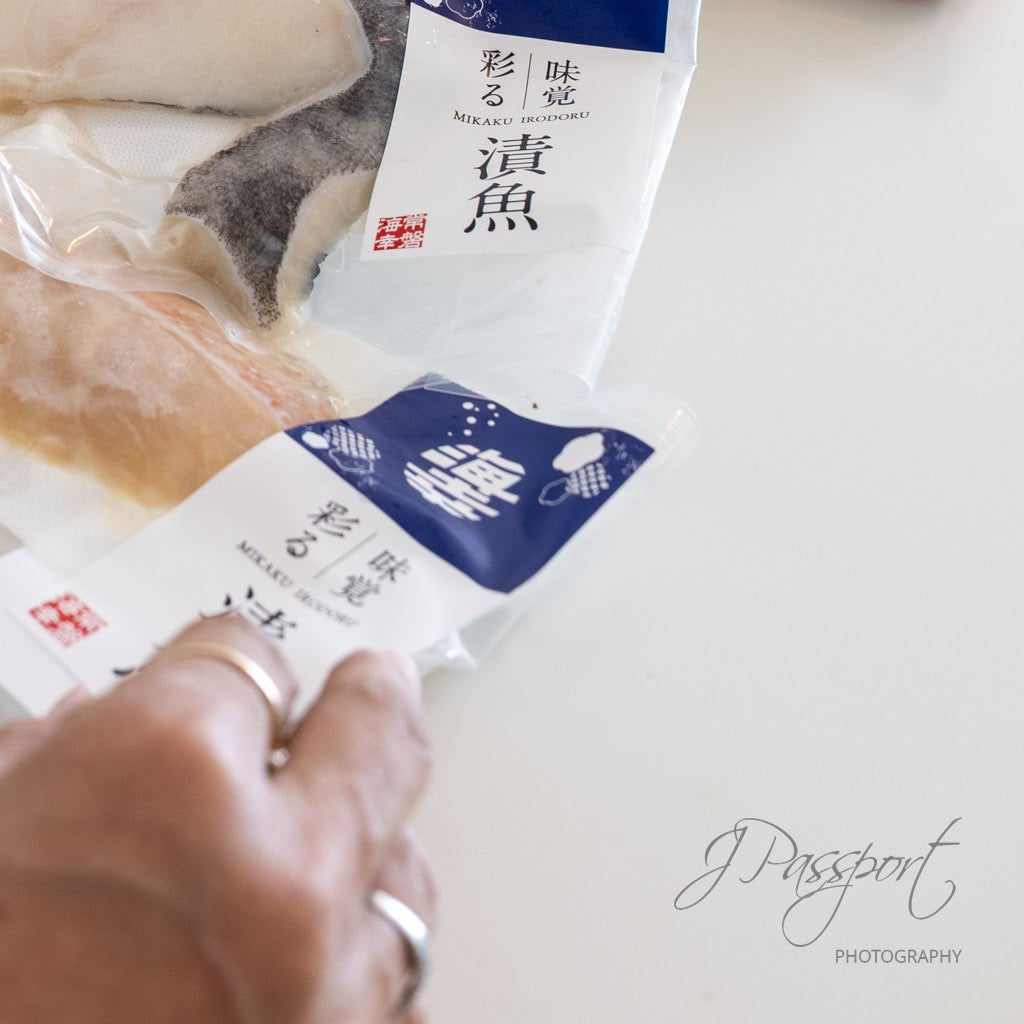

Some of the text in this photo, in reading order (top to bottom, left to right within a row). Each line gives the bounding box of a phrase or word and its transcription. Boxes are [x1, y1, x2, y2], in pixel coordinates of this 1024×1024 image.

[480, 49, 516, 107] 彩る
[541, 59, 581, 108] 味覚
[453, 110, 590, 126] MIKAKU IRODORU
[463, 134, 553, 233] 漬魚
